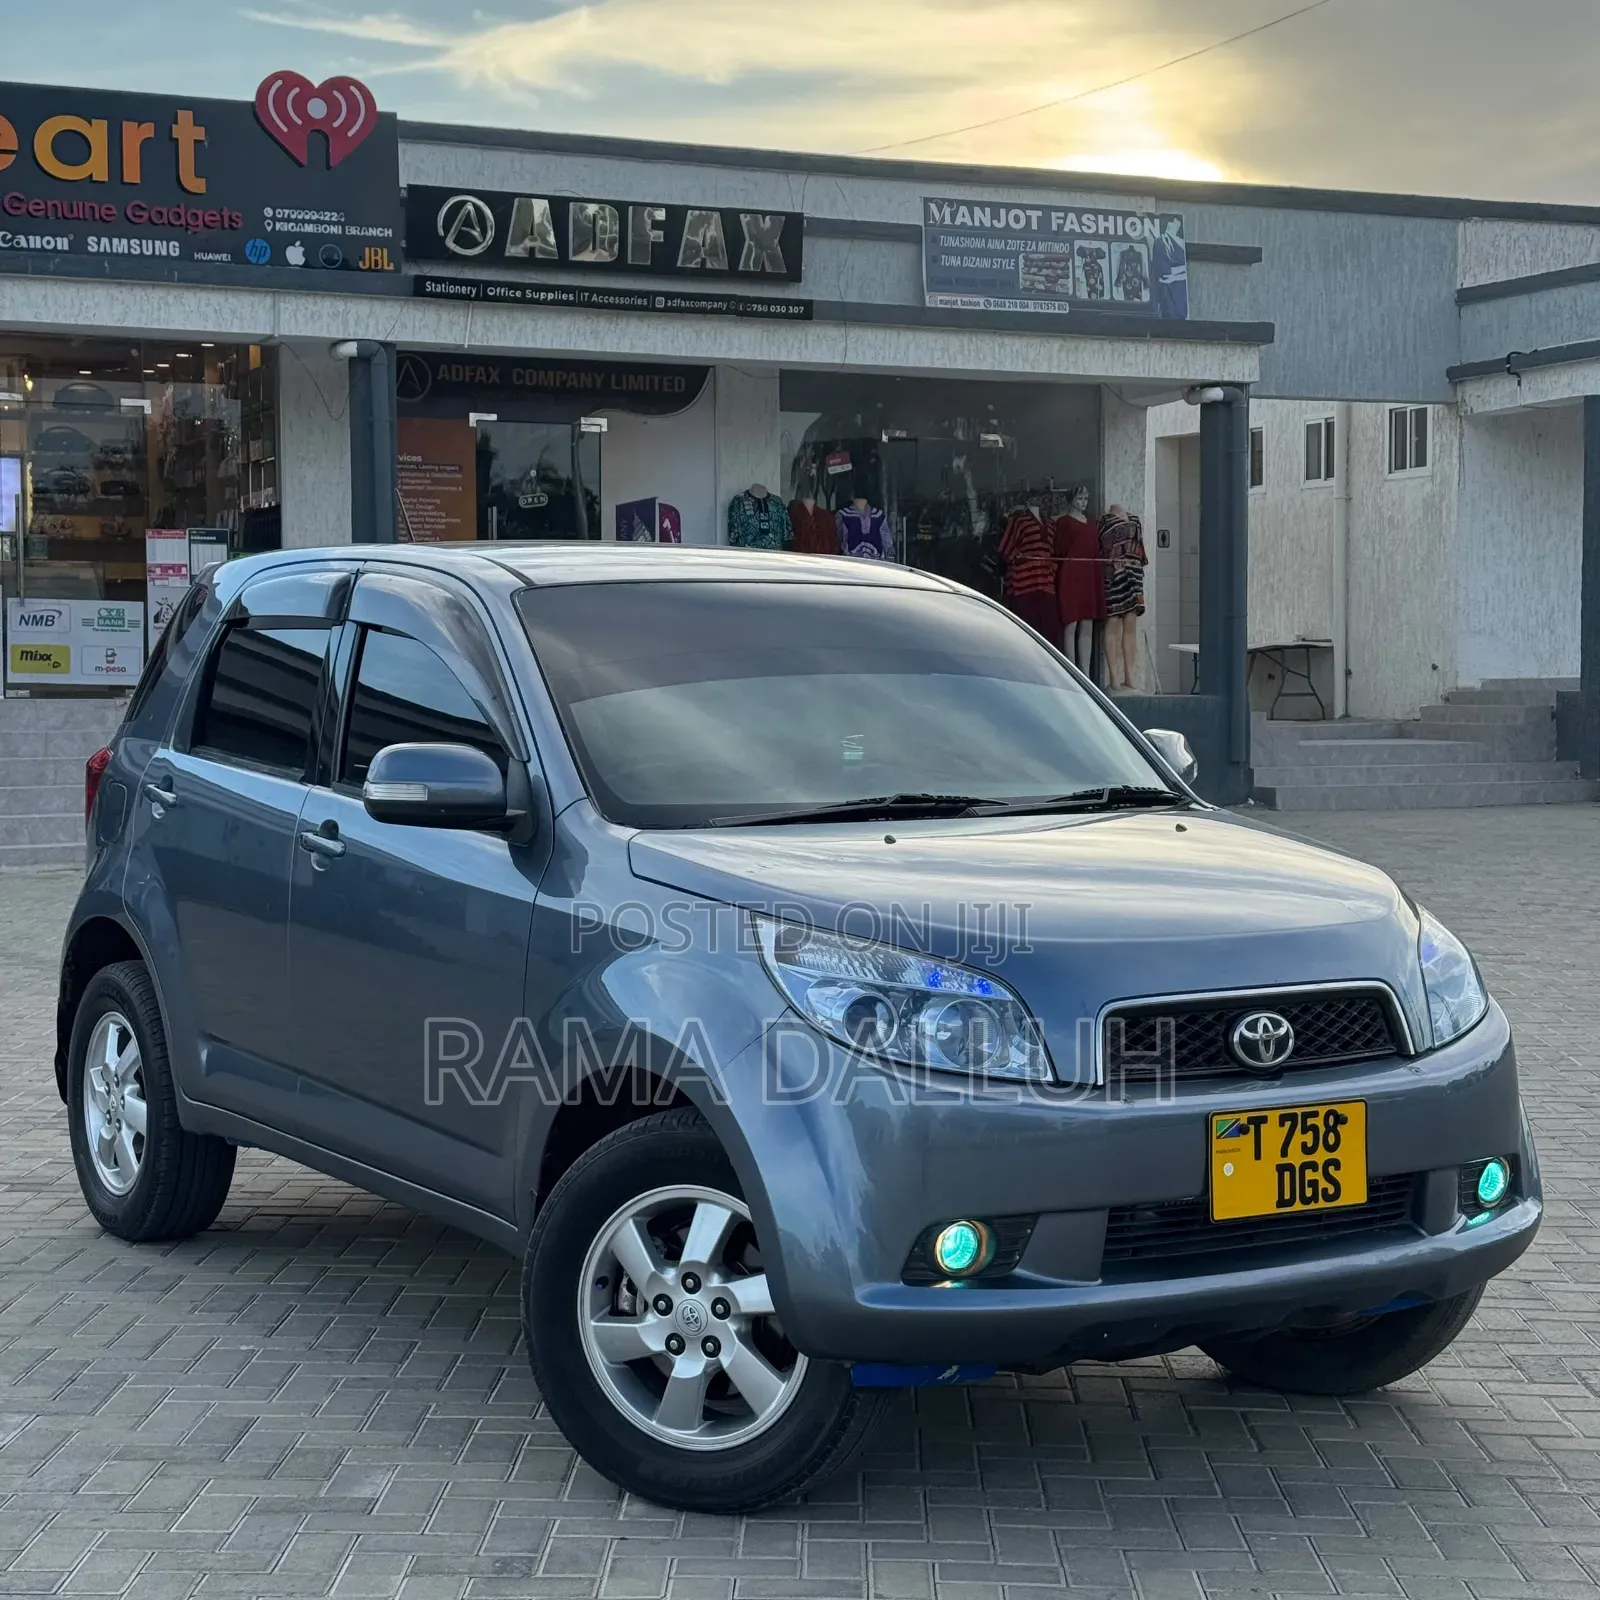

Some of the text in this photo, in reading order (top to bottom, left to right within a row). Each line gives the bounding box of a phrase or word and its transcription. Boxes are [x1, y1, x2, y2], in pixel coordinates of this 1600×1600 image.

[0, 109, 206, 194] art
[124, 200, 244, 234] Gadgets
[927, 200, 1161, 238] MANJOT FASHION
[0, 231, 70, 250] Canon
[275, 222, 393, 237] KIGAMBONI BRANCH
[504, 197, 788, 274] ADFAX
[87, 236, 180, 256] SAMSUNG
[247, 240, 270, 264] hp
[939, 235, 1070, 254] TUNASHONA AINA ZOTE ZA MITINDO
[194, 252, 231, 262] HUAWEI
[359, 247, 394, 270] JBL
[941, 255, 1016, 270] TUNA DIZAINI STYLE
[425, 281, 477, 297] Stationery
[486, 286, 522, 298] Office
[525, 289, 575, 302] Supplies
[580, 292, 589, 302] IT
[591, 293, 648, 306] Accessories
[666, 298, 728, 310] adfaxcompany
[770, 305, 787, 313] 030
[788, 306, 805, 314] 307
[437, 363, 686, 393] ADFAX COMPANY LIMITED
[19, 614, 55, 627] NMB
[98, 618, 125, 628] BANK
[19, 650, 53, 661] mixx
[1247, 1109, 1342, 1160] T 758
[1275, 1158, 1342, 1208] DGS
